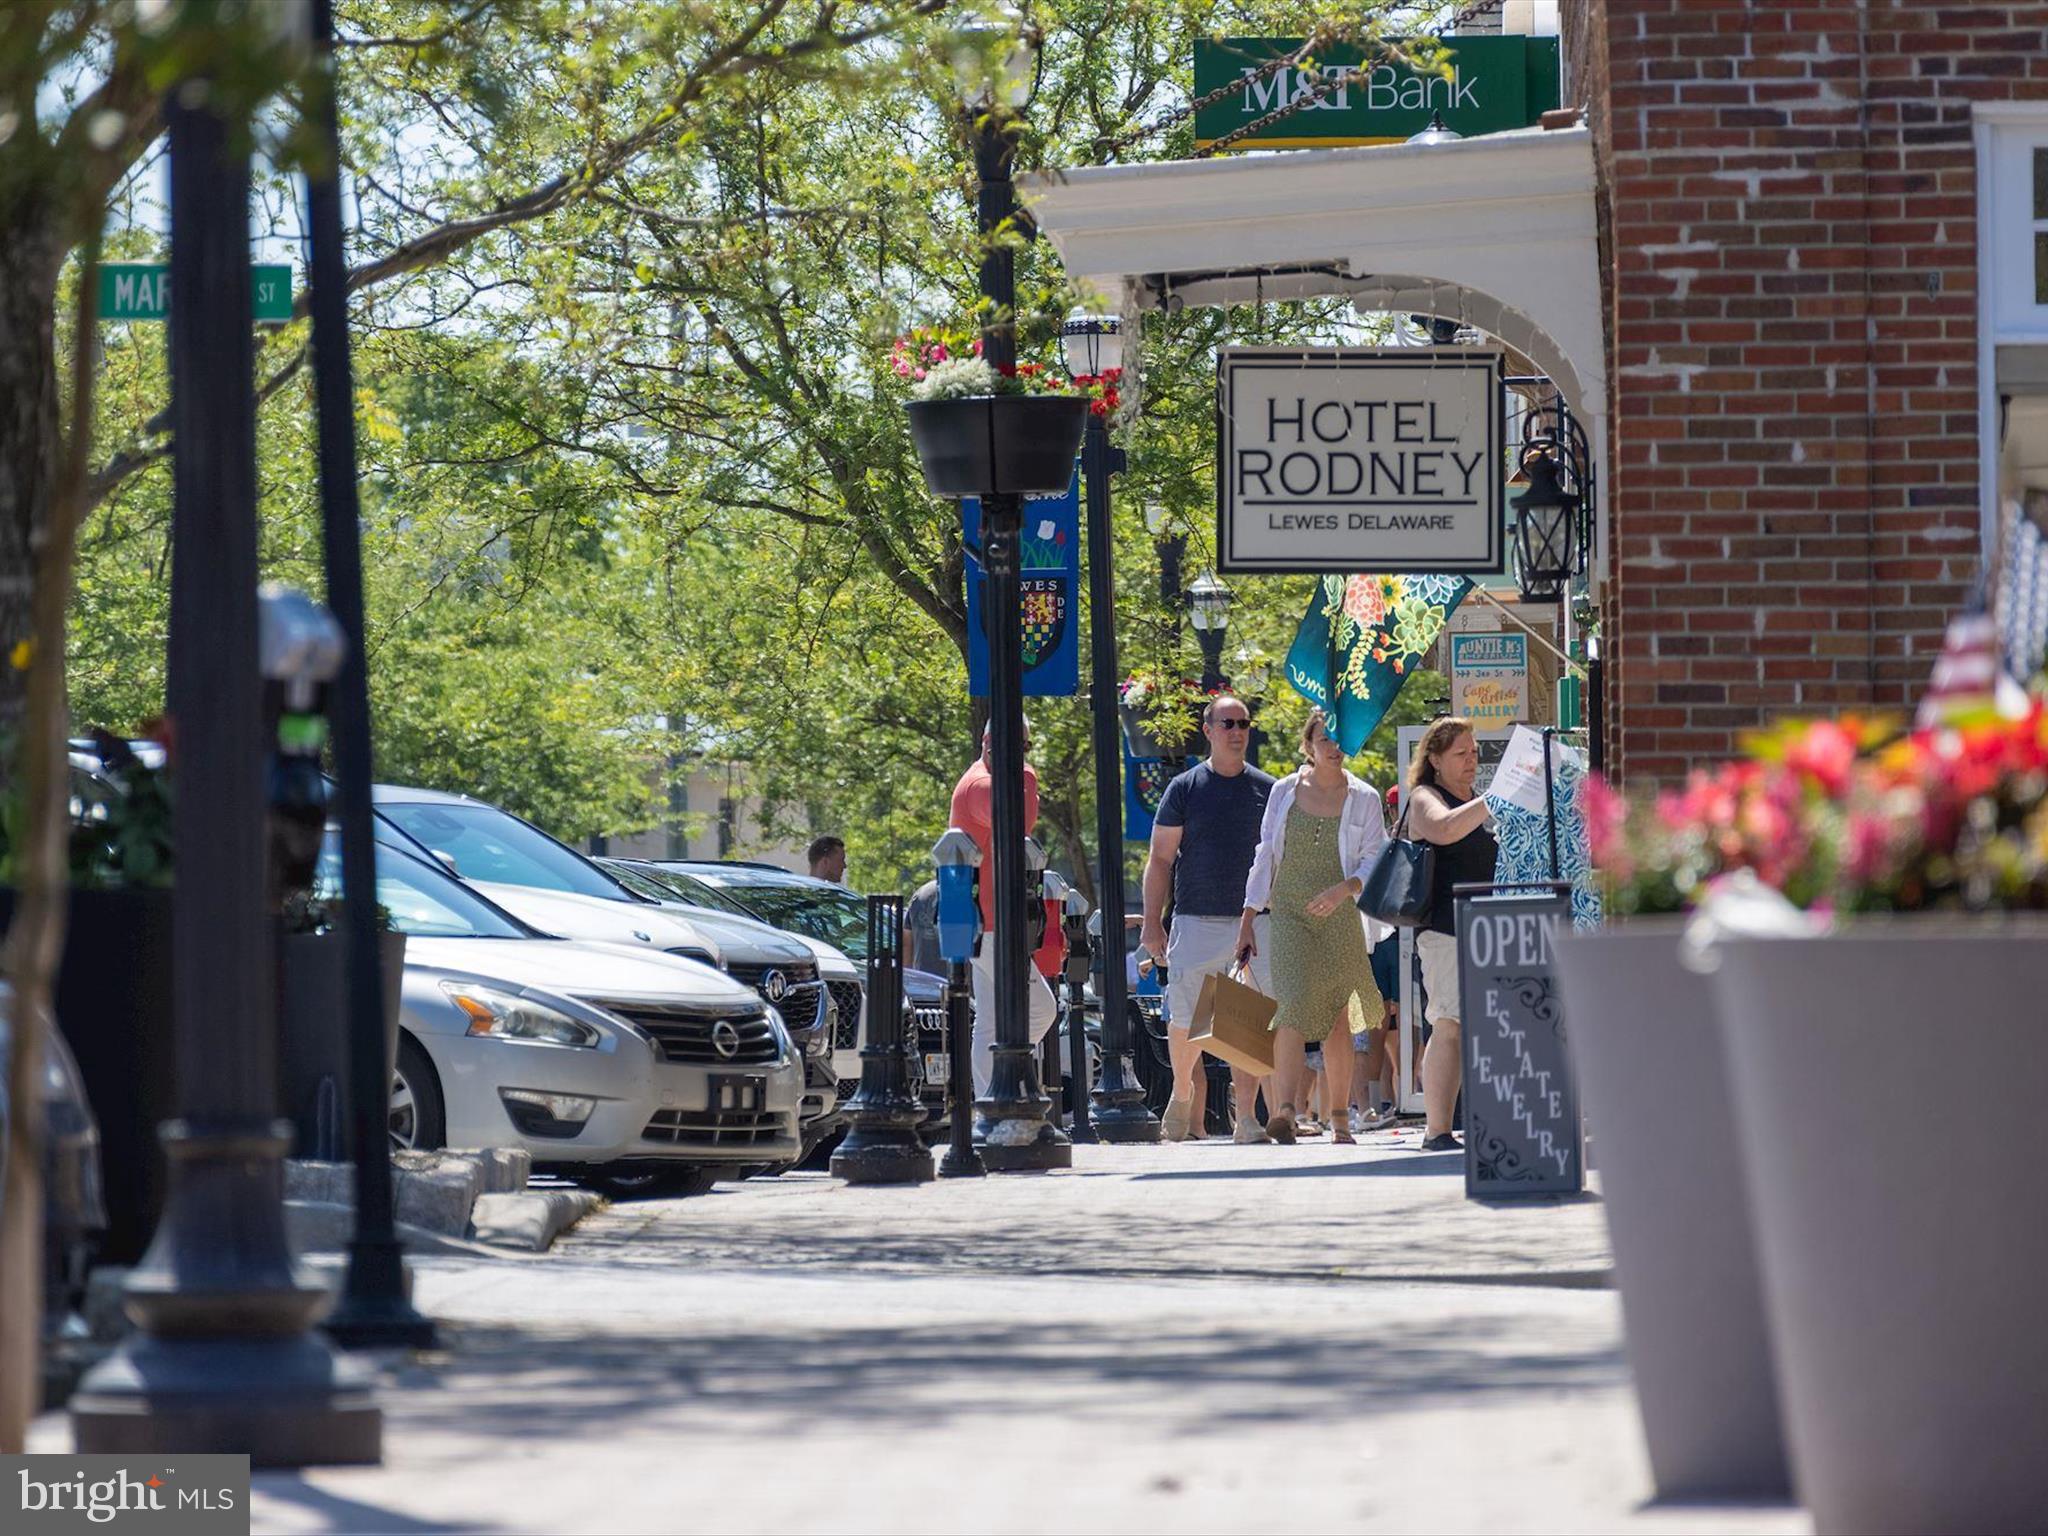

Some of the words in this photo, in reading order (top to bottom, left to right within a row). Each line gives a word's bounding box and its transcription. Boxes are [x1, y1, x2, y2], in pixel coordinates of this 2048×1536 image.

[1240, 65, 1352, 112] M&T
[1367, 64, 1480, 110] Bank
[258, 282, 276, 303] ST
[1267, 398, 1458, 443] HOTEL
[1237, 449, 1484, 496] RODNEY
[1268, 513, 1338, 530] LEWES
[1348, 513, 1454, 530] DELAWARE
[1463, 704, 1520, 717] GALLERY
[1469, 914, 1560, 967] OPEN
[1486, 990, 1562, 1119] ESTATE
[1472, 1036, 1569, 1176] JEWELRY
